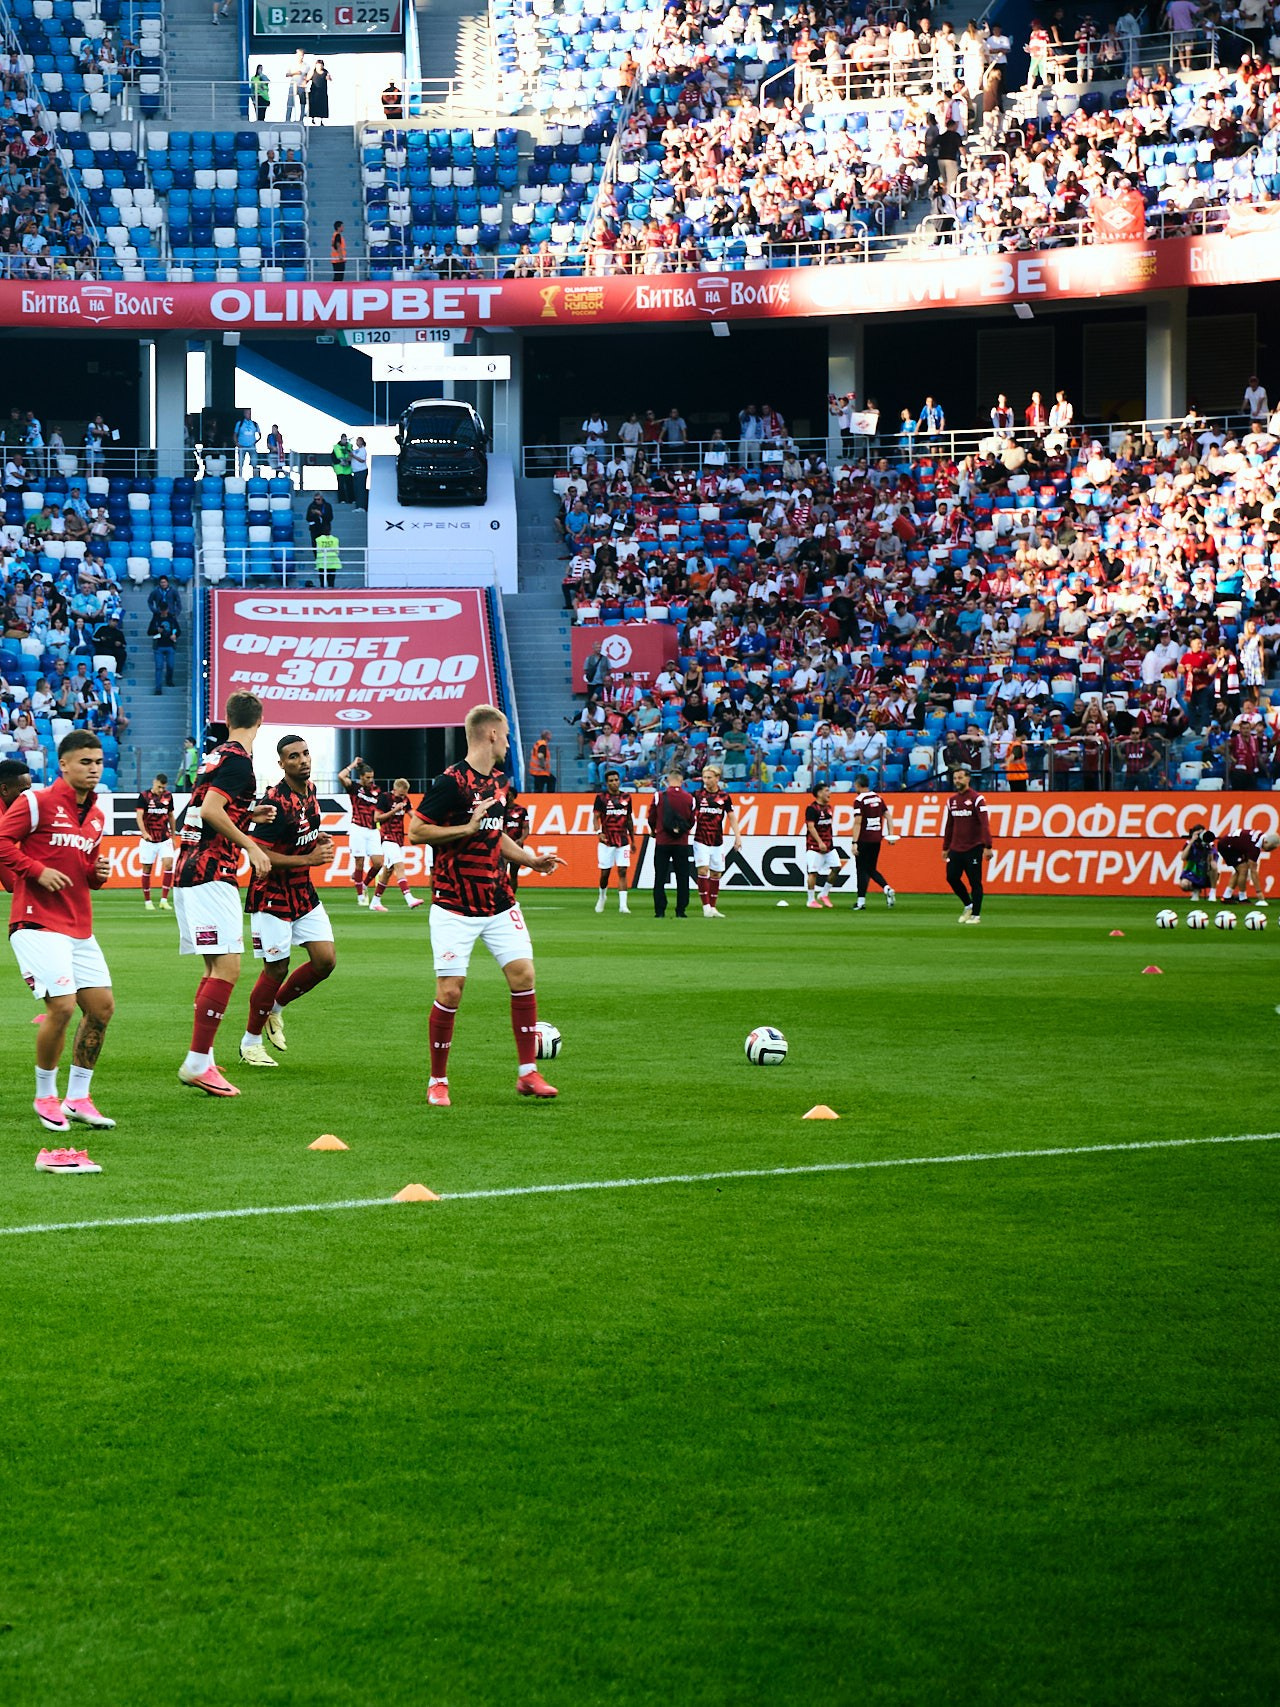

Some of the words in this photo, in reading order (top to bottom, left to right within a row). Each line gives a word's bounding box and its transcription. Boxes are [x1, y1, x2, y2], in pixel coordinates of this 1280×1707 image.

[290, 9, 323, 23] 226
[357, 8, 390, 23] 225
[210, 286, 503, 322] OLIMPBET
[367, 331, 391, 343] 120
[429, 330, 451, 341] 119
[252, 604, 444, 616] OLIMPBET
[223, 633, 410, 659] ФРИБЕТ
[275, 659, 355, 687] 30
[360, 654, 480, 687] 000
[250, 684, 345, 703] НОВЫМ
[345, 684, 466, 703] ИГРОКАМ
[49, 833, 94, 855] ЛУКОЙ
